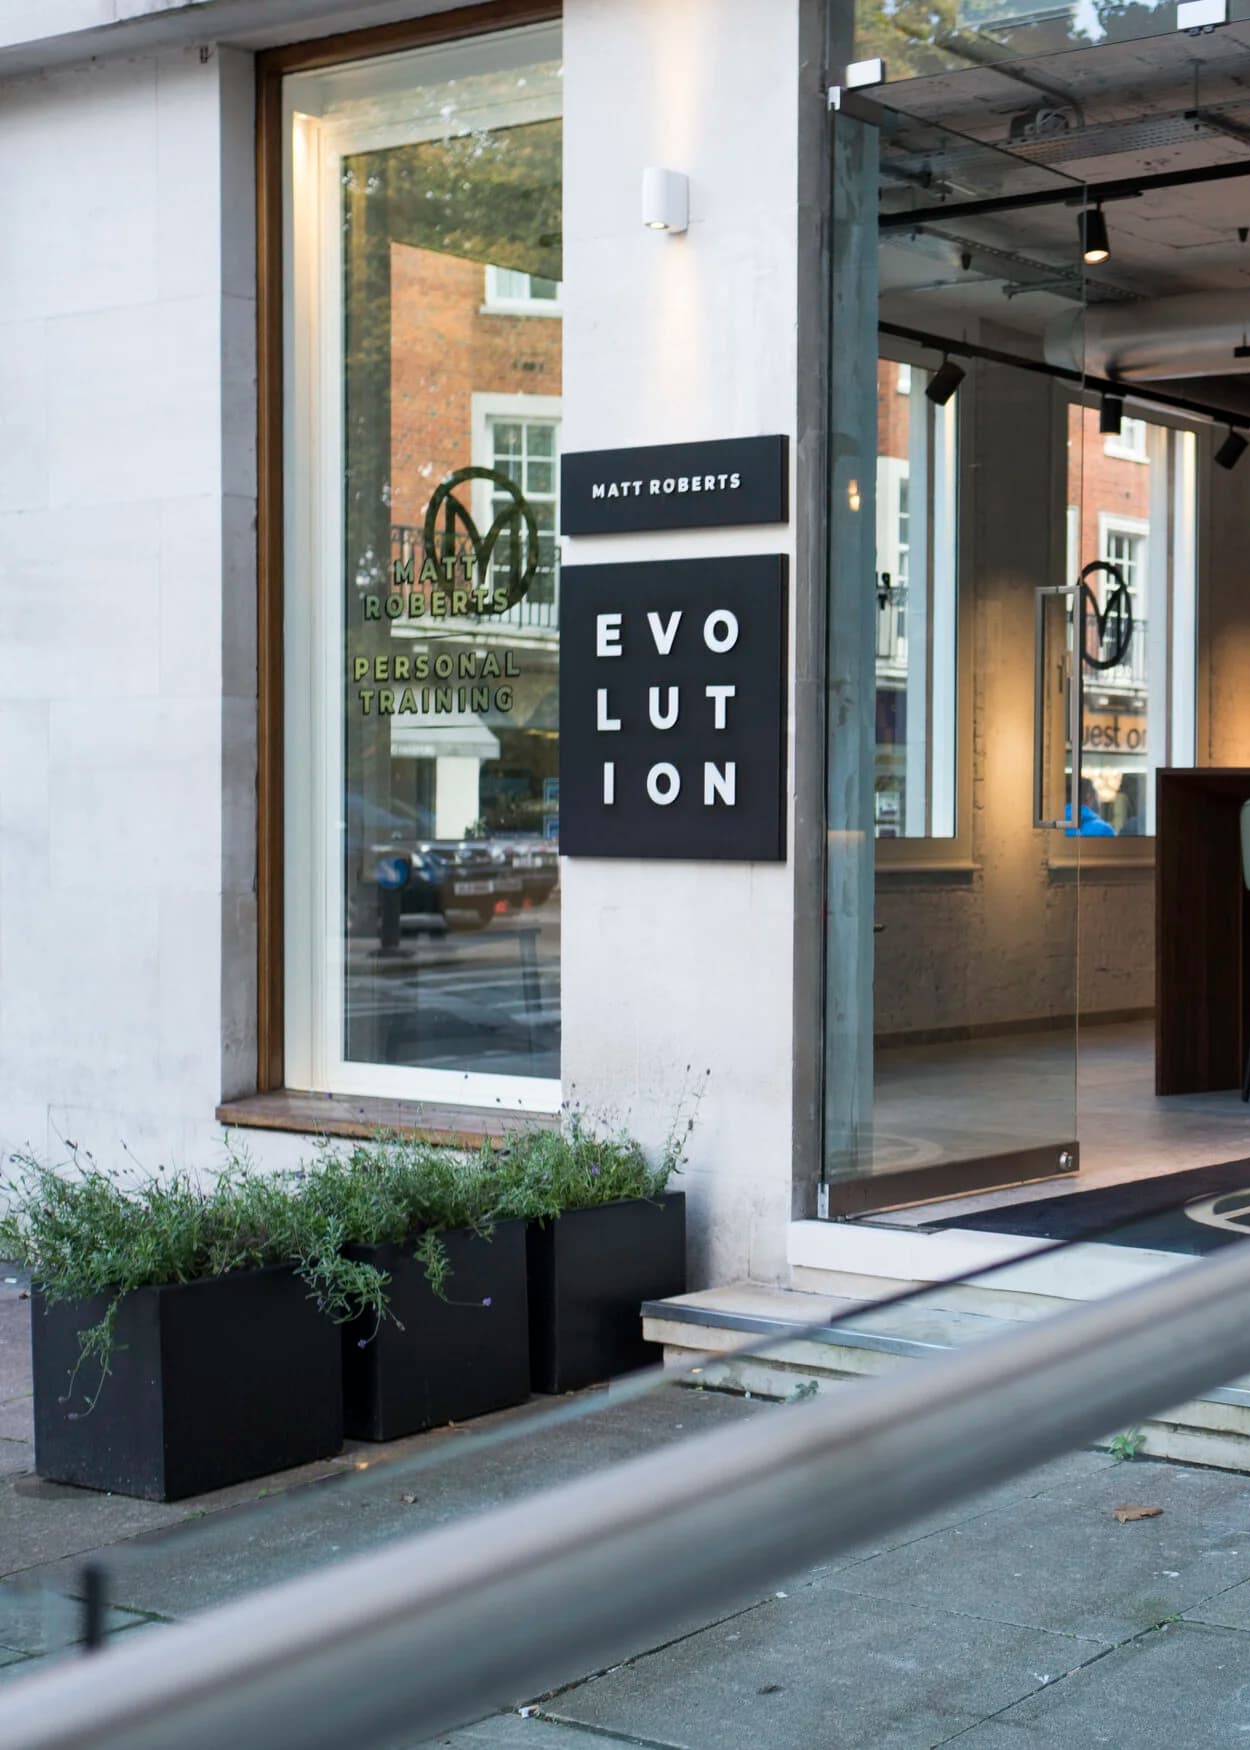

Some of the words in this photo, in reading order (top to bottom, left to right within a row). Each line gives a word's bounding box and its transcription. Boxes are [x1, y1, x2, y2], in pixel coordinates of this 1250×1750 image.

[592, 480, 643, 499] MATT
[649, 473, 740, 495] ROBERTS
[394, 555, 477, 585] MATT
[364, 587, 508, 620] ROBERTS
[596, 609, 739, 657] EVO
[354, 651, 521, 682] PERSONAL
[360, 685, 514, 714] TRAINING
[597, 685, 736, 731] LUT
[603, 761, 736, 806] ION
